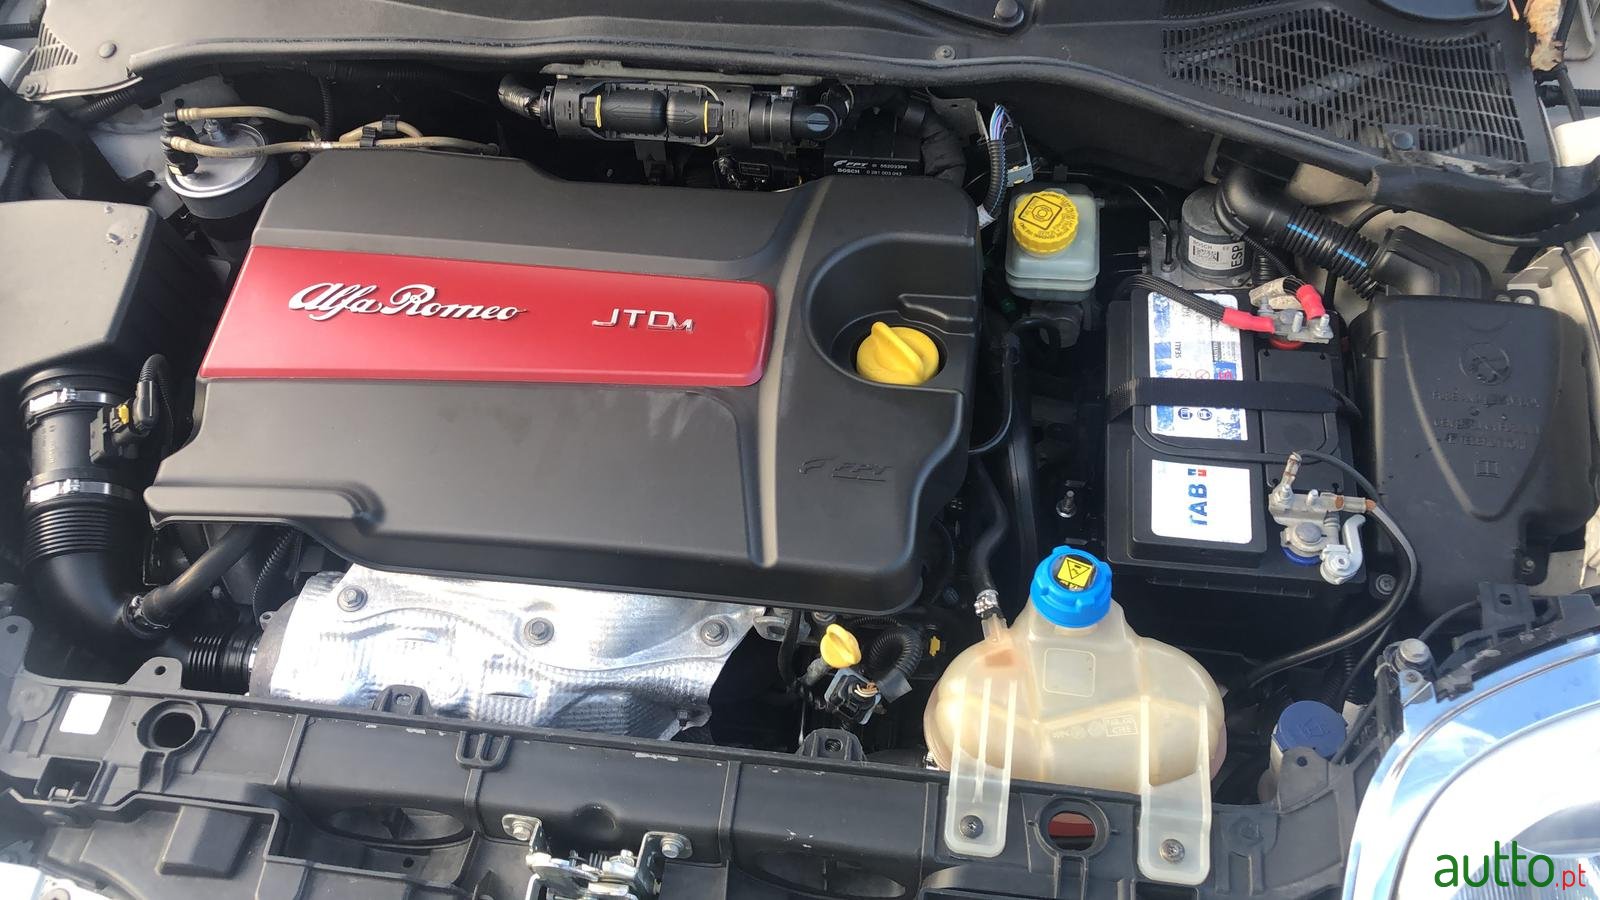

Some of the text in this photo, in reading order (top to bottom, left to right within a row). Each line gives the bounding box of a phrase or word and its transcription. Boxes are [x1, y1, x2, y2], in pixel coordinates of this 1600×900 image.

[1231, 245, 1243, 267] ESP
[288, 282, 528, 321] Alfa Romeo
